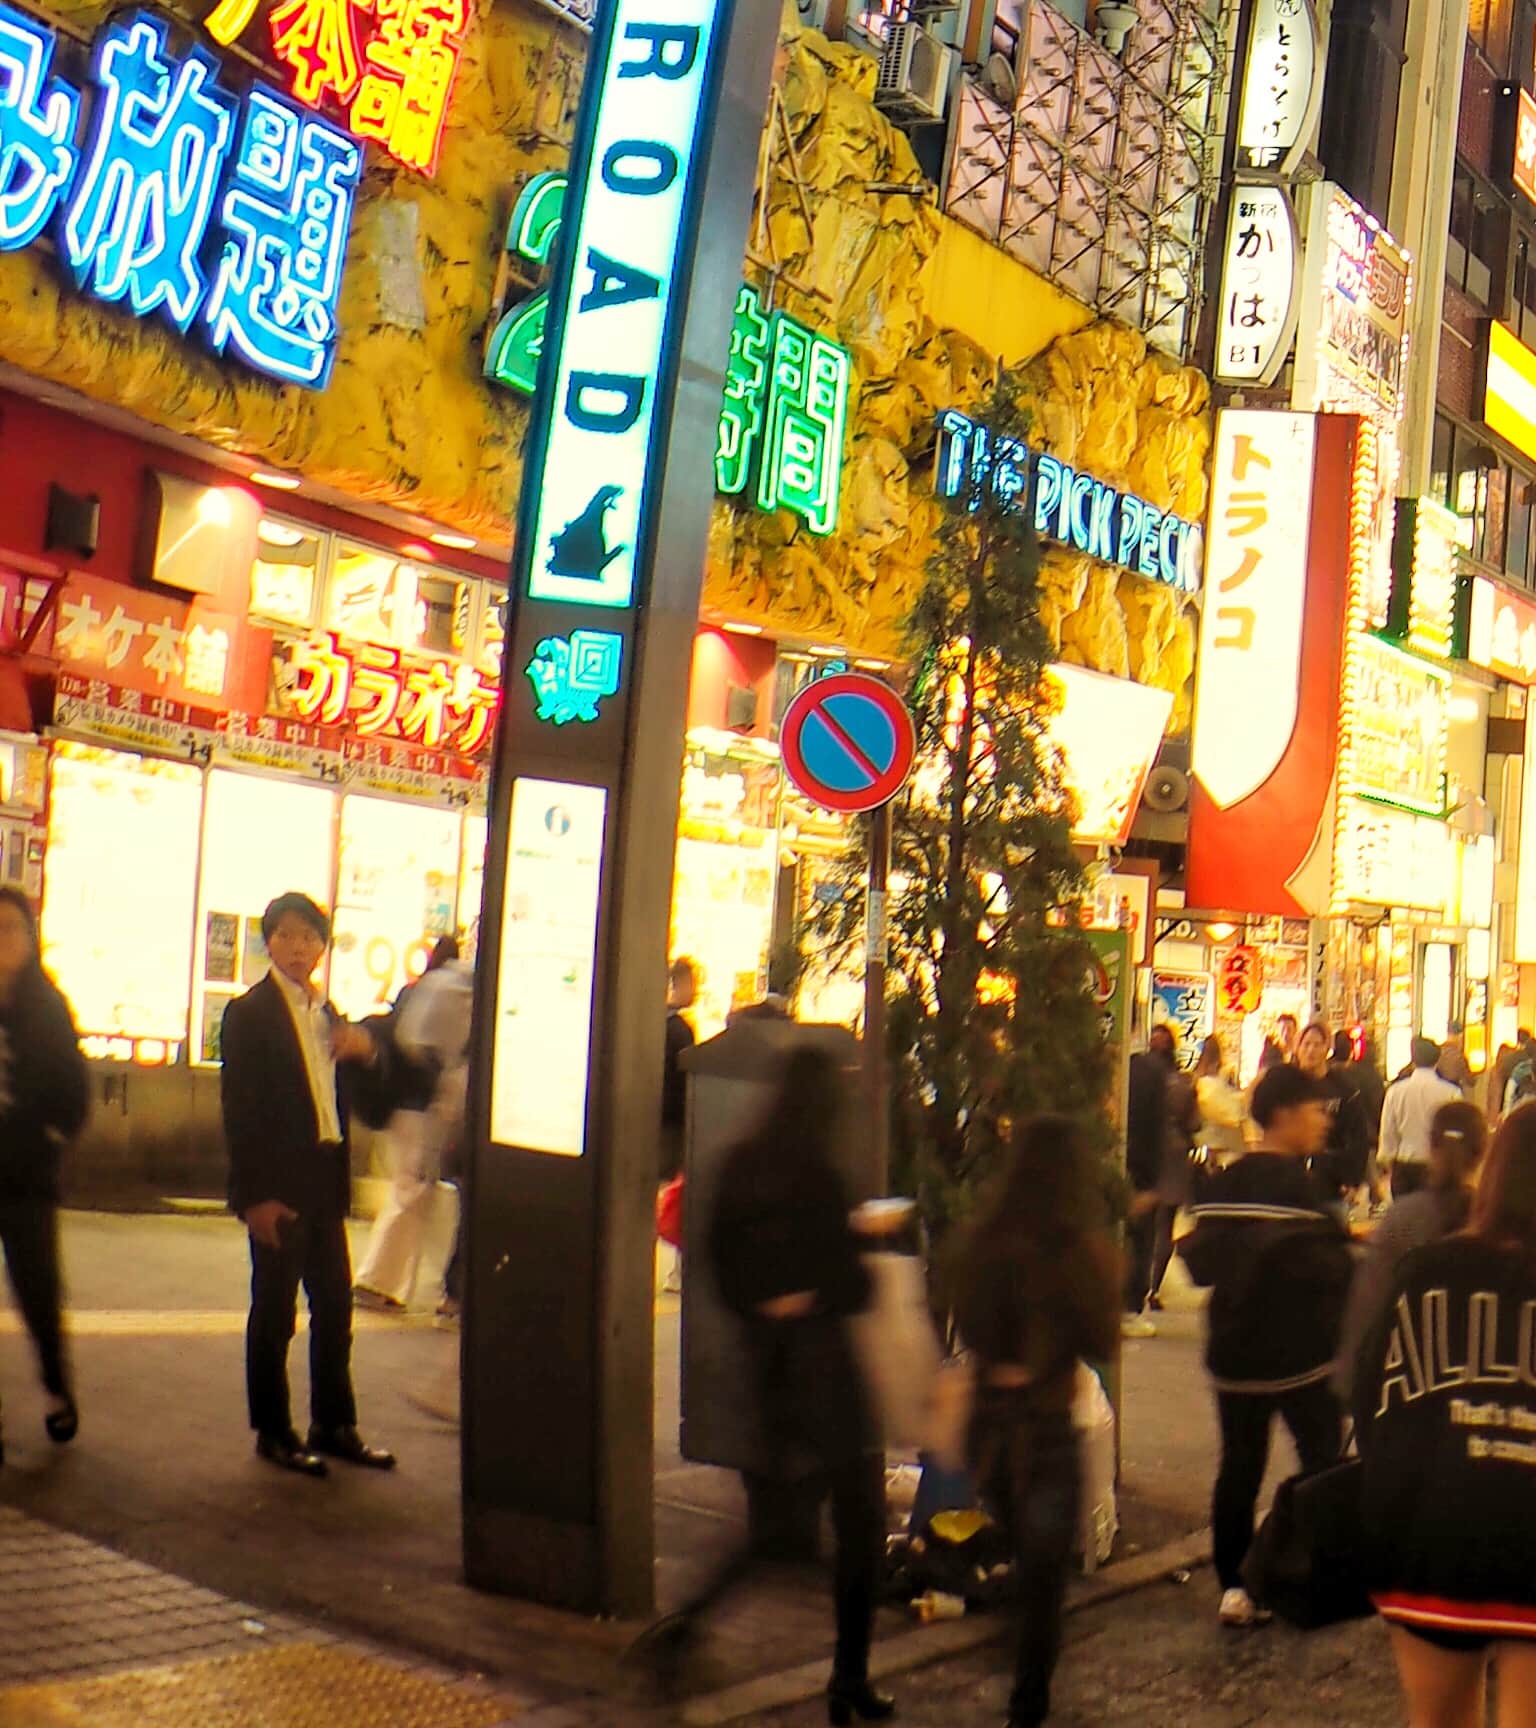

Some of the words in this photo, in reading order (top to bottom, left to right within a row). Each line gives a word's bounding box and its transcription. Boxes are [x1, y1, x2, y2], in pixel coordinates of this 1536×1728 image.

[1247, 147, 1280, 168] 1F
[564, 22, 700, 433] ROAD
[1228, 344, 1262, 366] B1
[1036, 452, 1114, 563] PICK
[1119, 496, 1202, 594] PECK
[1211, 432, 1271, 653] トラノコ
[289, 628, 502, 757] カラオケ
